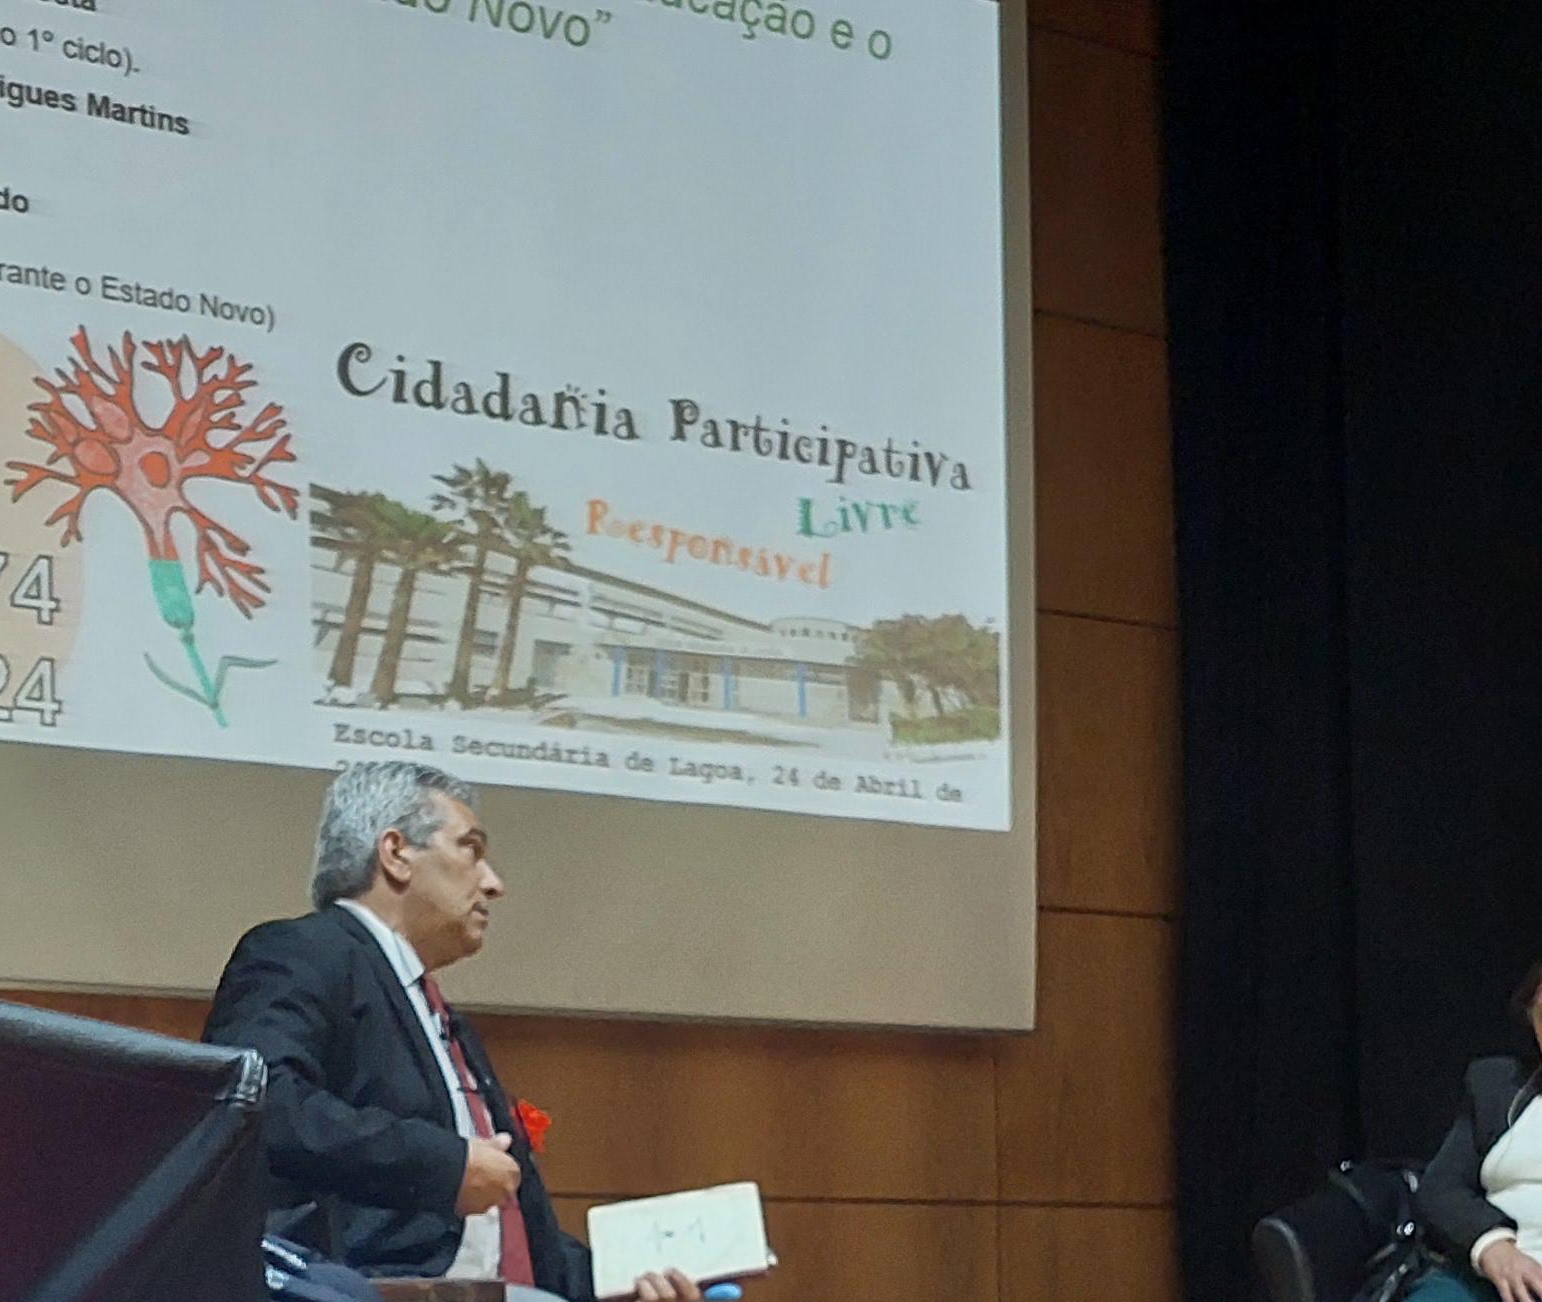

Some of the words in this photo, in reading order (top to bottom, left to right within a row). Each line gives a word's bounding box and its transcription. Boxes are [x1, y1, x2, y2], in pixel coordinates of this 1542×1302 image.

[27, 31, 54, 51] 1º
[62, 40, 140, 77] ciclo).
[831, 19, 854, 50] e
[868, 29, 891, 60] o
[87, 93, 190, 135] Martins
[74, 277, 92, 295] o
[101, 275, 191, 312] Estado
[200, 293, 275, 333] Novo)
[337, 342, 641, 440] Cidadania
[669, 399, 971, 490] Participativa
[797, 496, 921, 538] Livre
[333, 723, 435, 751] Escola
[451, 735, 611, 768] Secundária
[624, 751, 657, 772] de
[668, 757, 755, 786] Lagoa,
[773, 765, 800, 787] 24
[811, 770, 844, 791] de
[854, 775, 925, 800] Abril
[936, 783, 963, 802] de
